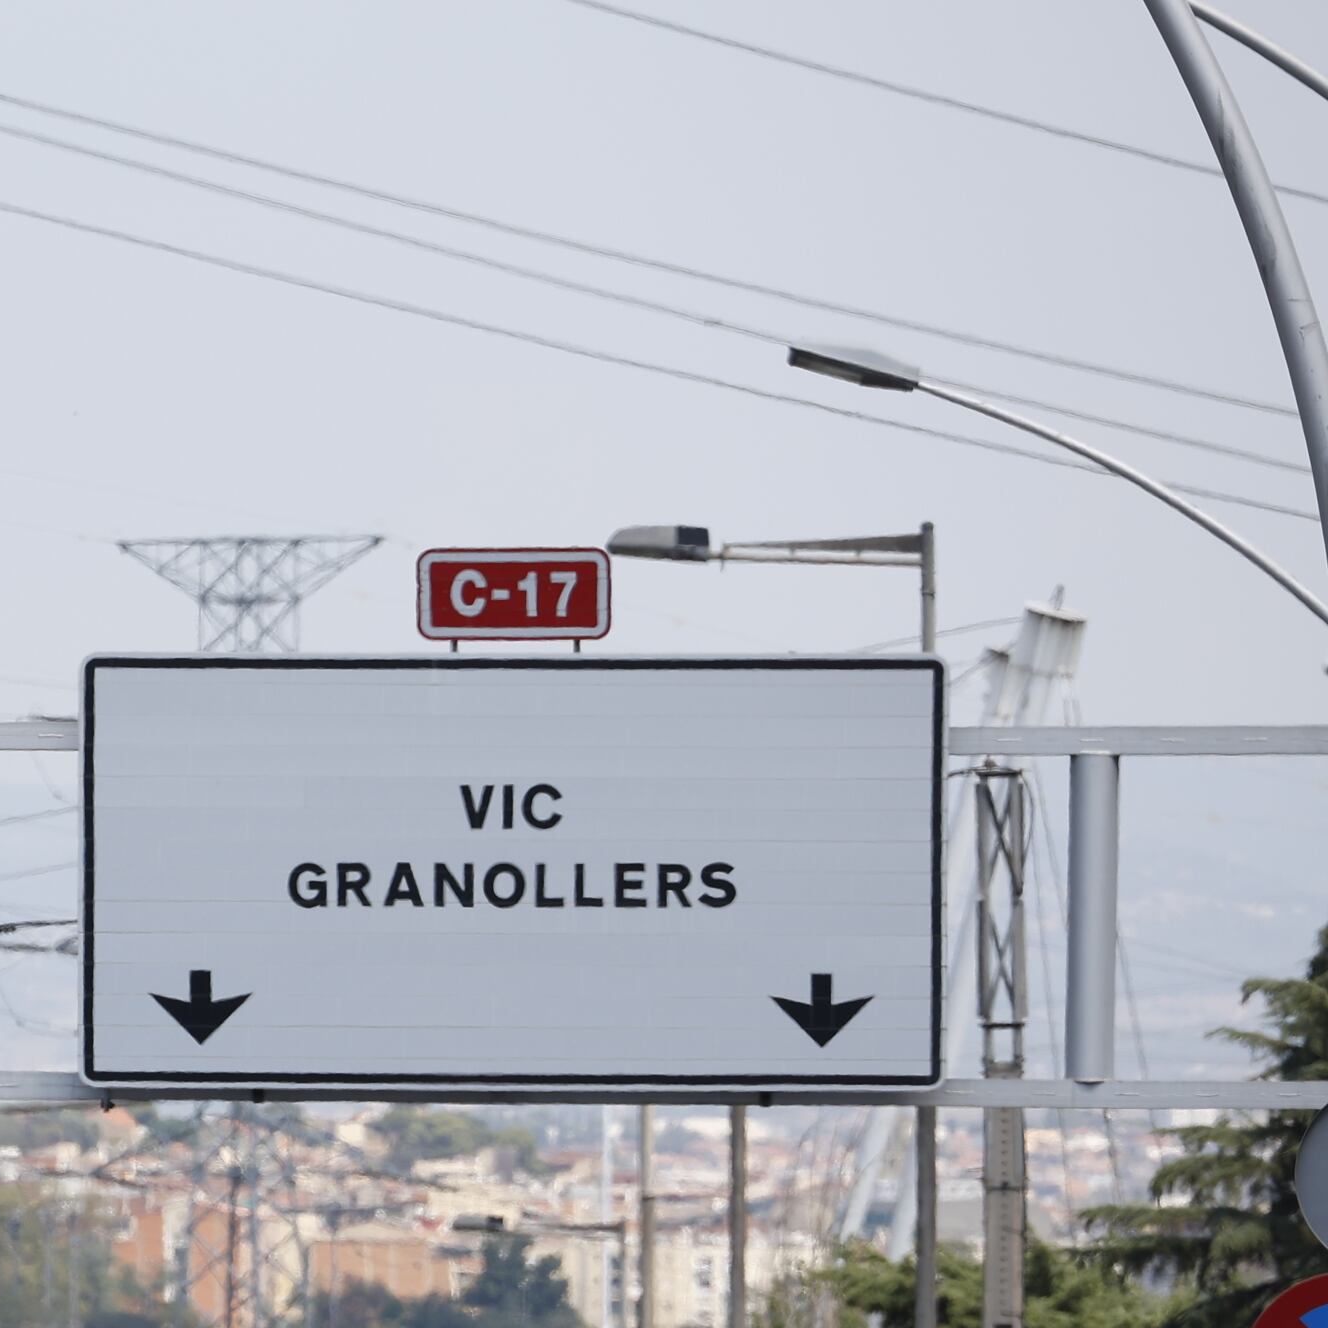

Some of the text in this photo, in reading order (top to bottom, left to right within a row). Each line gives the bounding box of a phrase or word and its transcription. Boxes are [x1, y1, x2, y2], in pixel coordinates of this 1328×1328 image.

[449, 571, 579, 618] C-17
[460, 784, 563, 829] VIC
[288, 862, 738, 909] GRANOLLERS
